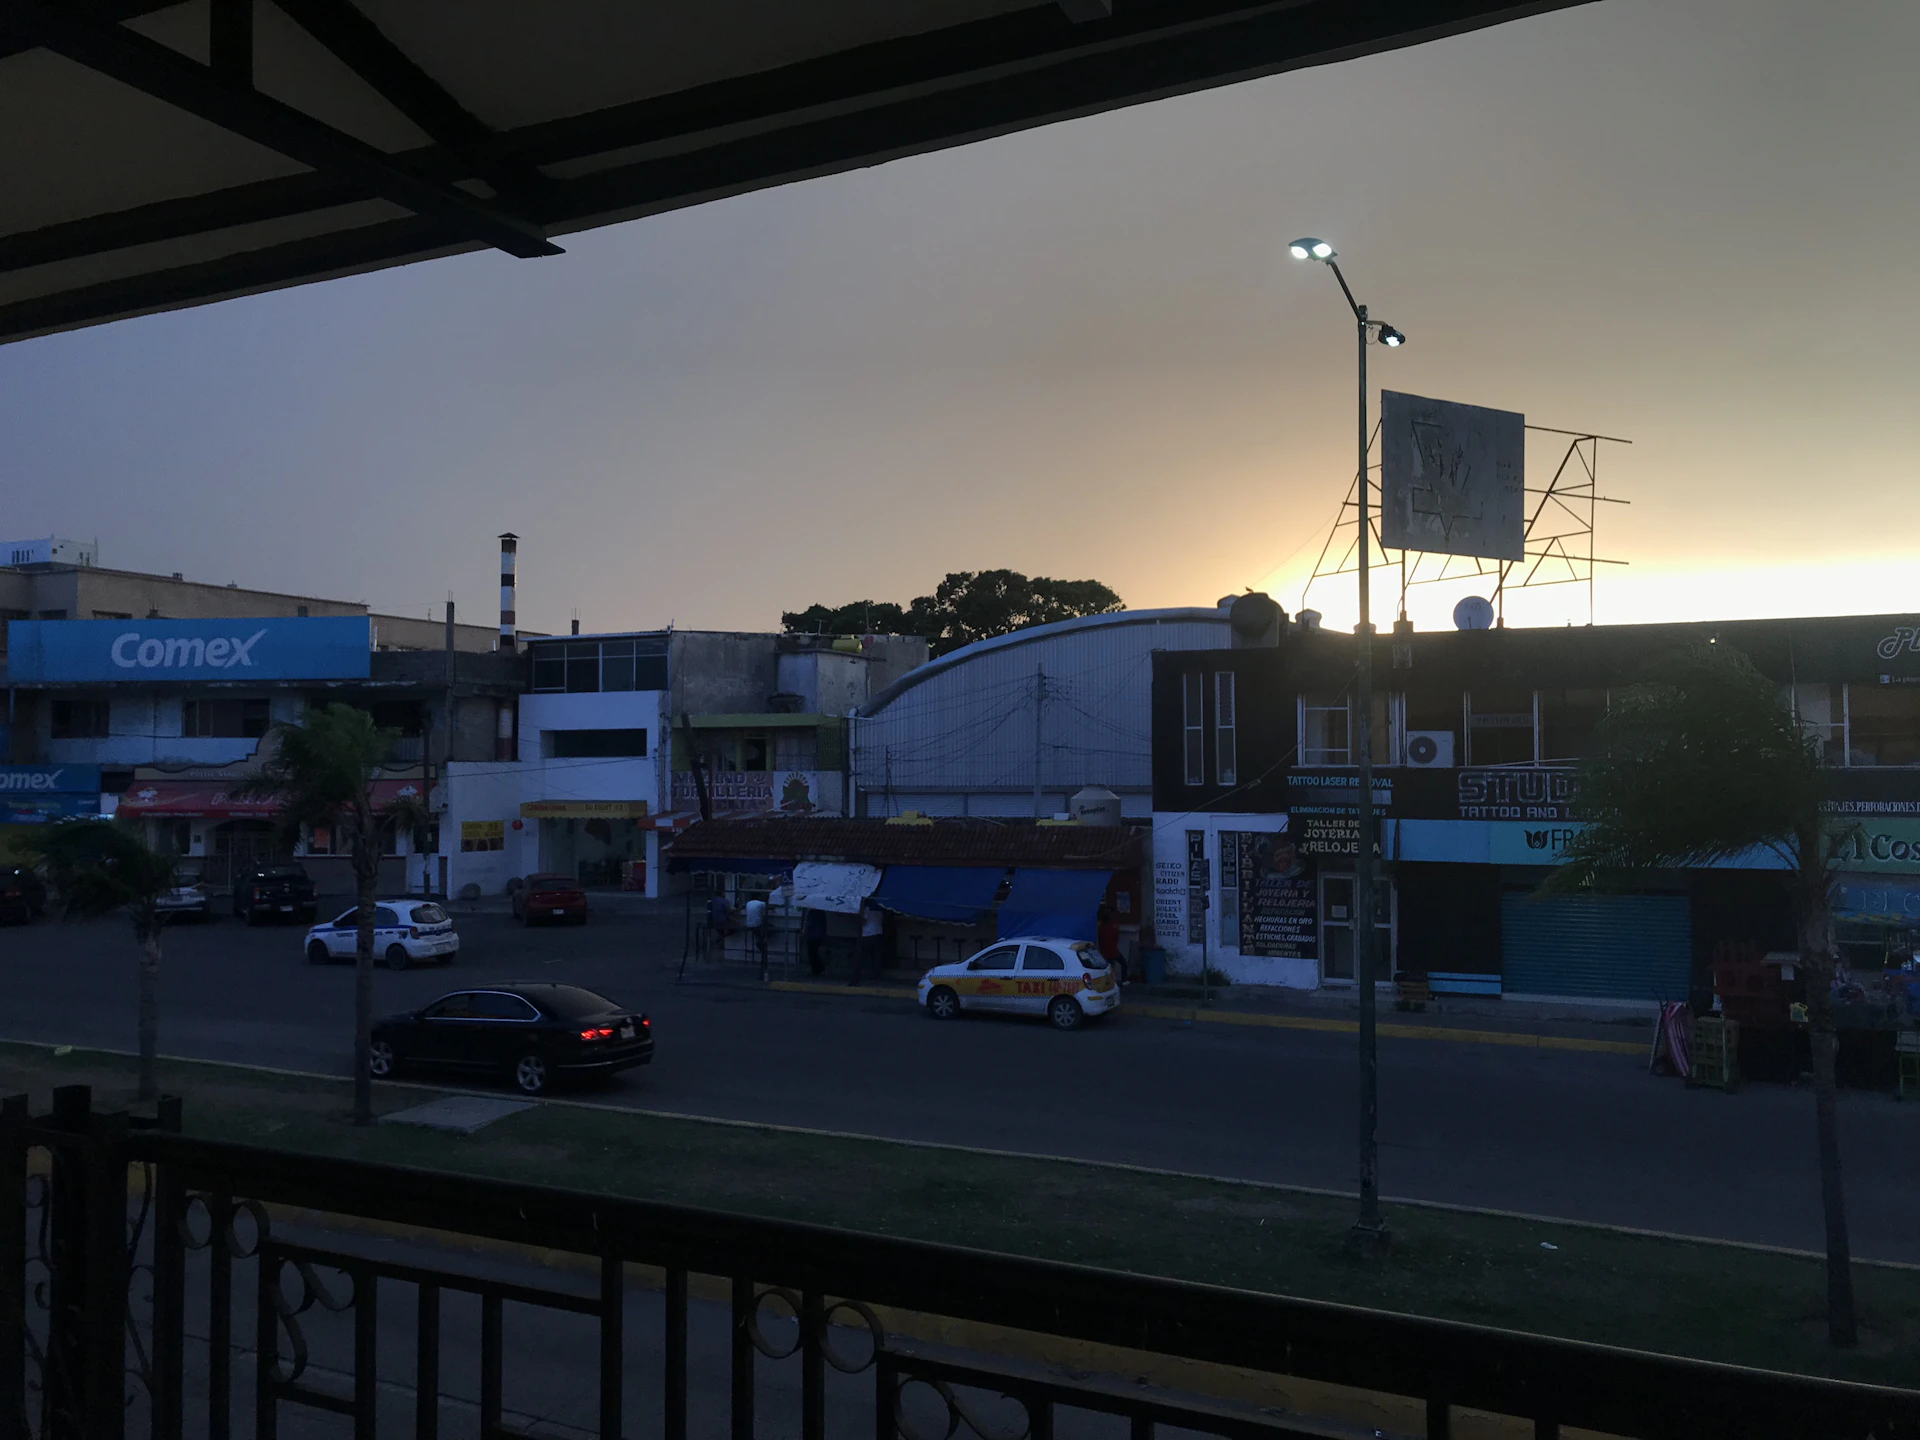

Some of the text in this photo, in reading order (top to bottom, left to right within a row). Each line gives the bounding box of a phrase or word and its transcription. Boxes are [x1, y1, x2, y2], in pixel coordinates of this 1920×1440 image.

[111, 628, 268, 669] Comex
[674, 773, 747, 785] MINO
[1287, 776, 1394, 788] TATTOO LASER REVAL
[672, 785, 774, 799] TORILLERIA
[1290, 806, 1387, 816] ELIMINACION DE TATJES
[1459, 806, 1520, 818] TATTOO
[1526, 806, 1557, 818] AND
[1307, 819, 1360, 828] TALLER DE
[1304, 828, 1360, 840] JOYERIA
[1310, 841, 1381, 855] RELOJEA
[1256, 888, 1310, 898] JOYERIA Y
[1257, 898, 1316, 908] RELOJERIA
[1254, 916, 1313, 925] HECHURAS EN ORO
[1260, 925, 1300, 933] REFACCIONES
[1016, 981, 1045, 994] TAXI
